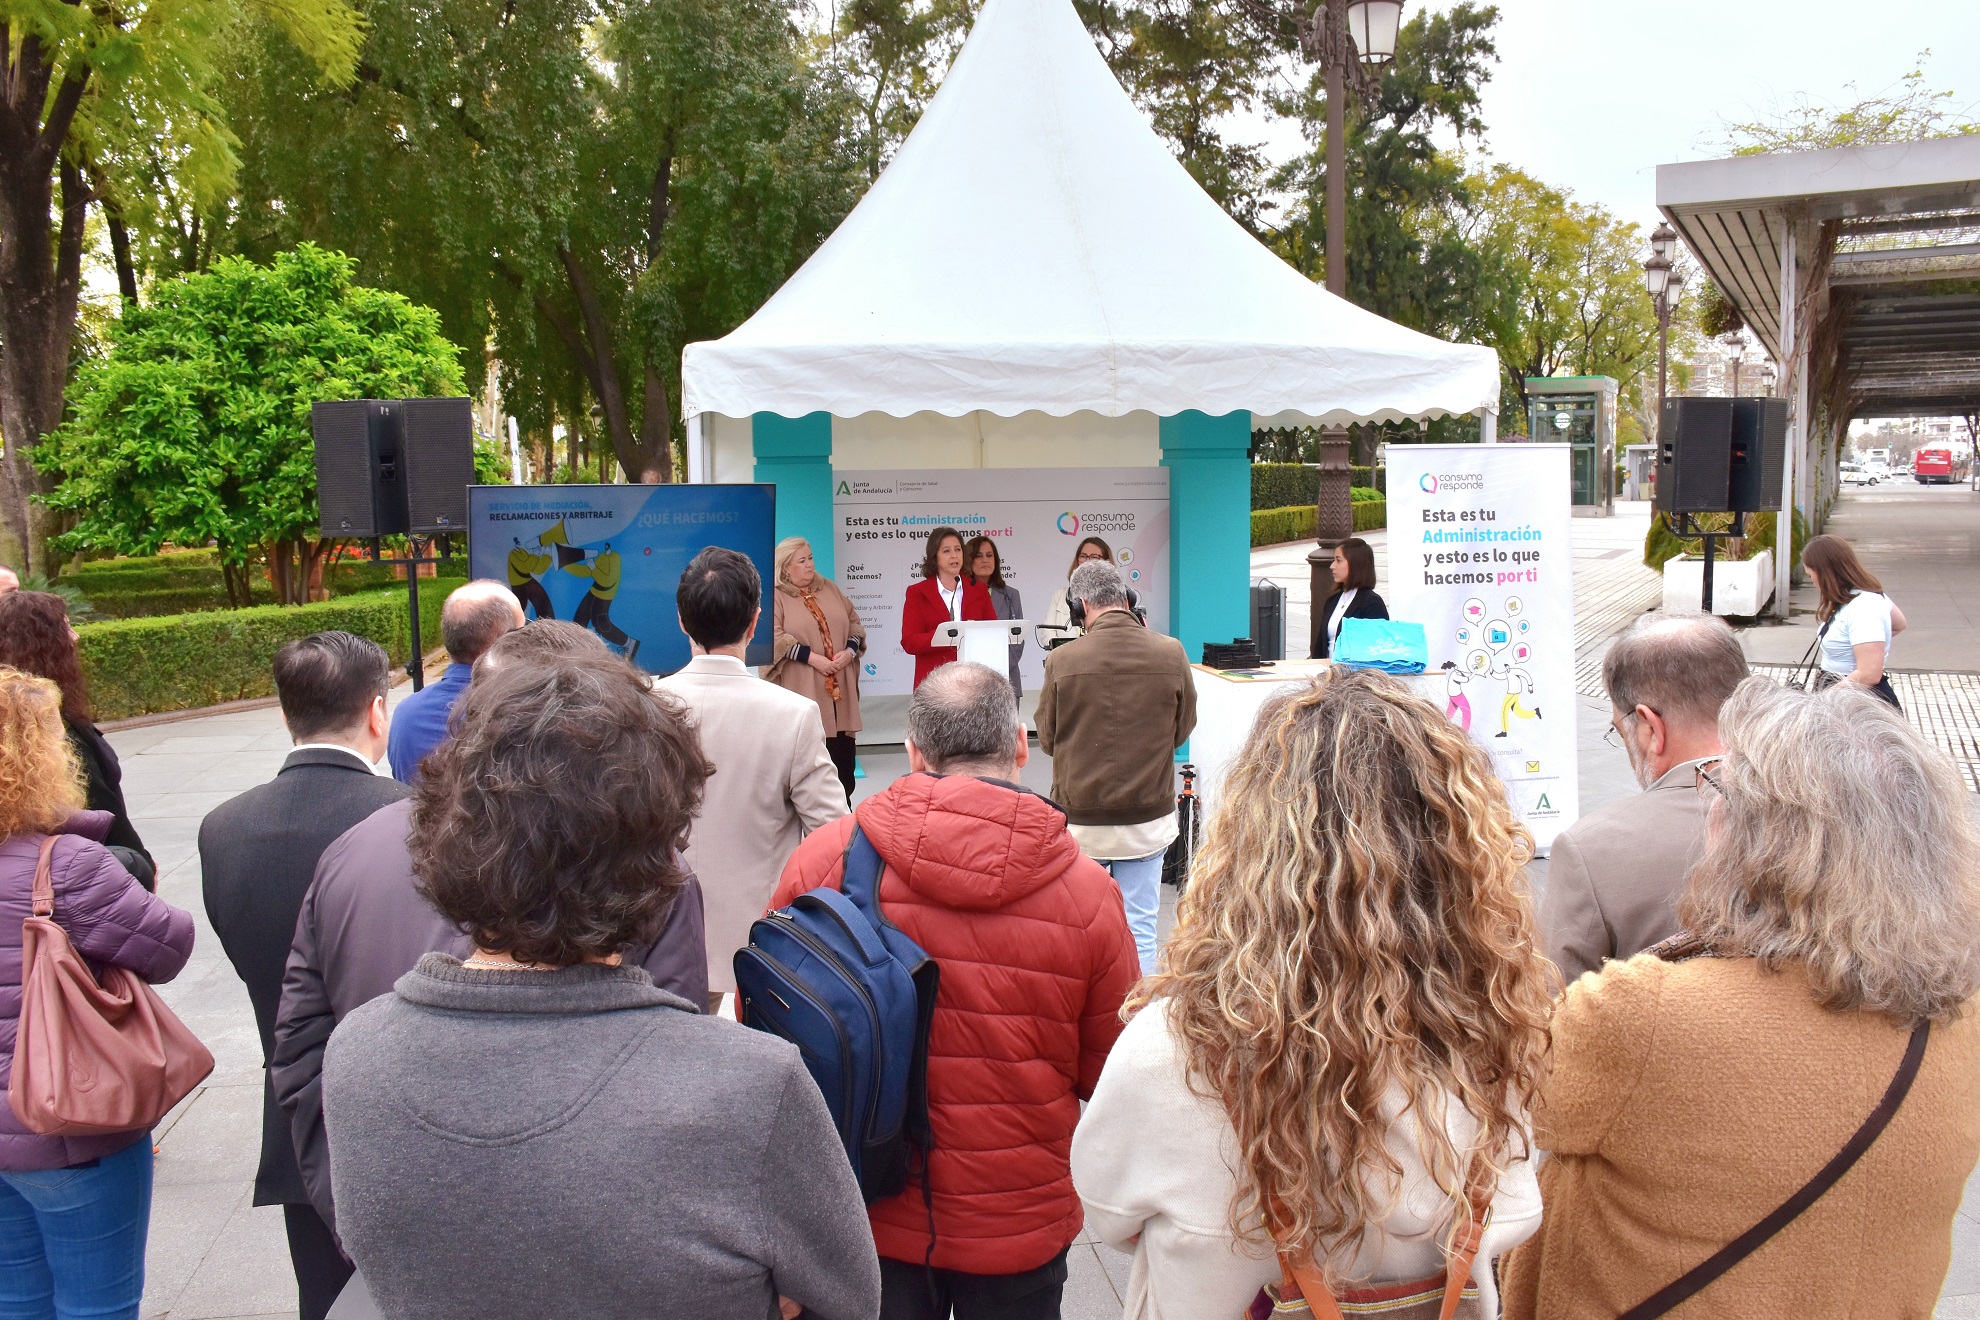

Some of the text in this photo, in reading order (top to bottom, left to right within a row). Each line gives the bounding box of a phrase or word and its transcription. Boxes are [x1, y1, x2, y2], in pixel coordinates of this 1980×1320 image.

[1439, 473, 1483, 481] consumo
[853, 481, 870, 489] Junta
[1439, 481, 1484, 492] responde
[489, 502, 530, 511] SERVICIO
[531, 502, 541, 510] DE
[489, 511, 613, 521] RECLAMACIONES Y ARBITRAJE
[637, 511, 739, 528] ¿QUÉ HACEMOS?
[845, 513, 987, 526] Esta es tu Administración
[1081, 512, 1135, 522] consumo
[1422, 508, 1496, 523] Esta es tu
[983, 528, 1003, 538] por
[1004, 527, 1013, 537] ti
[1081, 521, 1136, 534] responde
[845, 532, 853, 542] y
[854, 531, 879, 540] esto
[881, 531, 894, 539] es
[896, 529, 907, 539] lo
[909, 530, 930, 541] que
[1422, 524, 1542, 543] Administración
[1423, 548, 1540, 568] y esto es lo que
[847, 564, 865, 573] ¿Qué
[1424, 567, 1538, 586] hacemos por ti
[1497, 748, 1523, 756] consulta?
